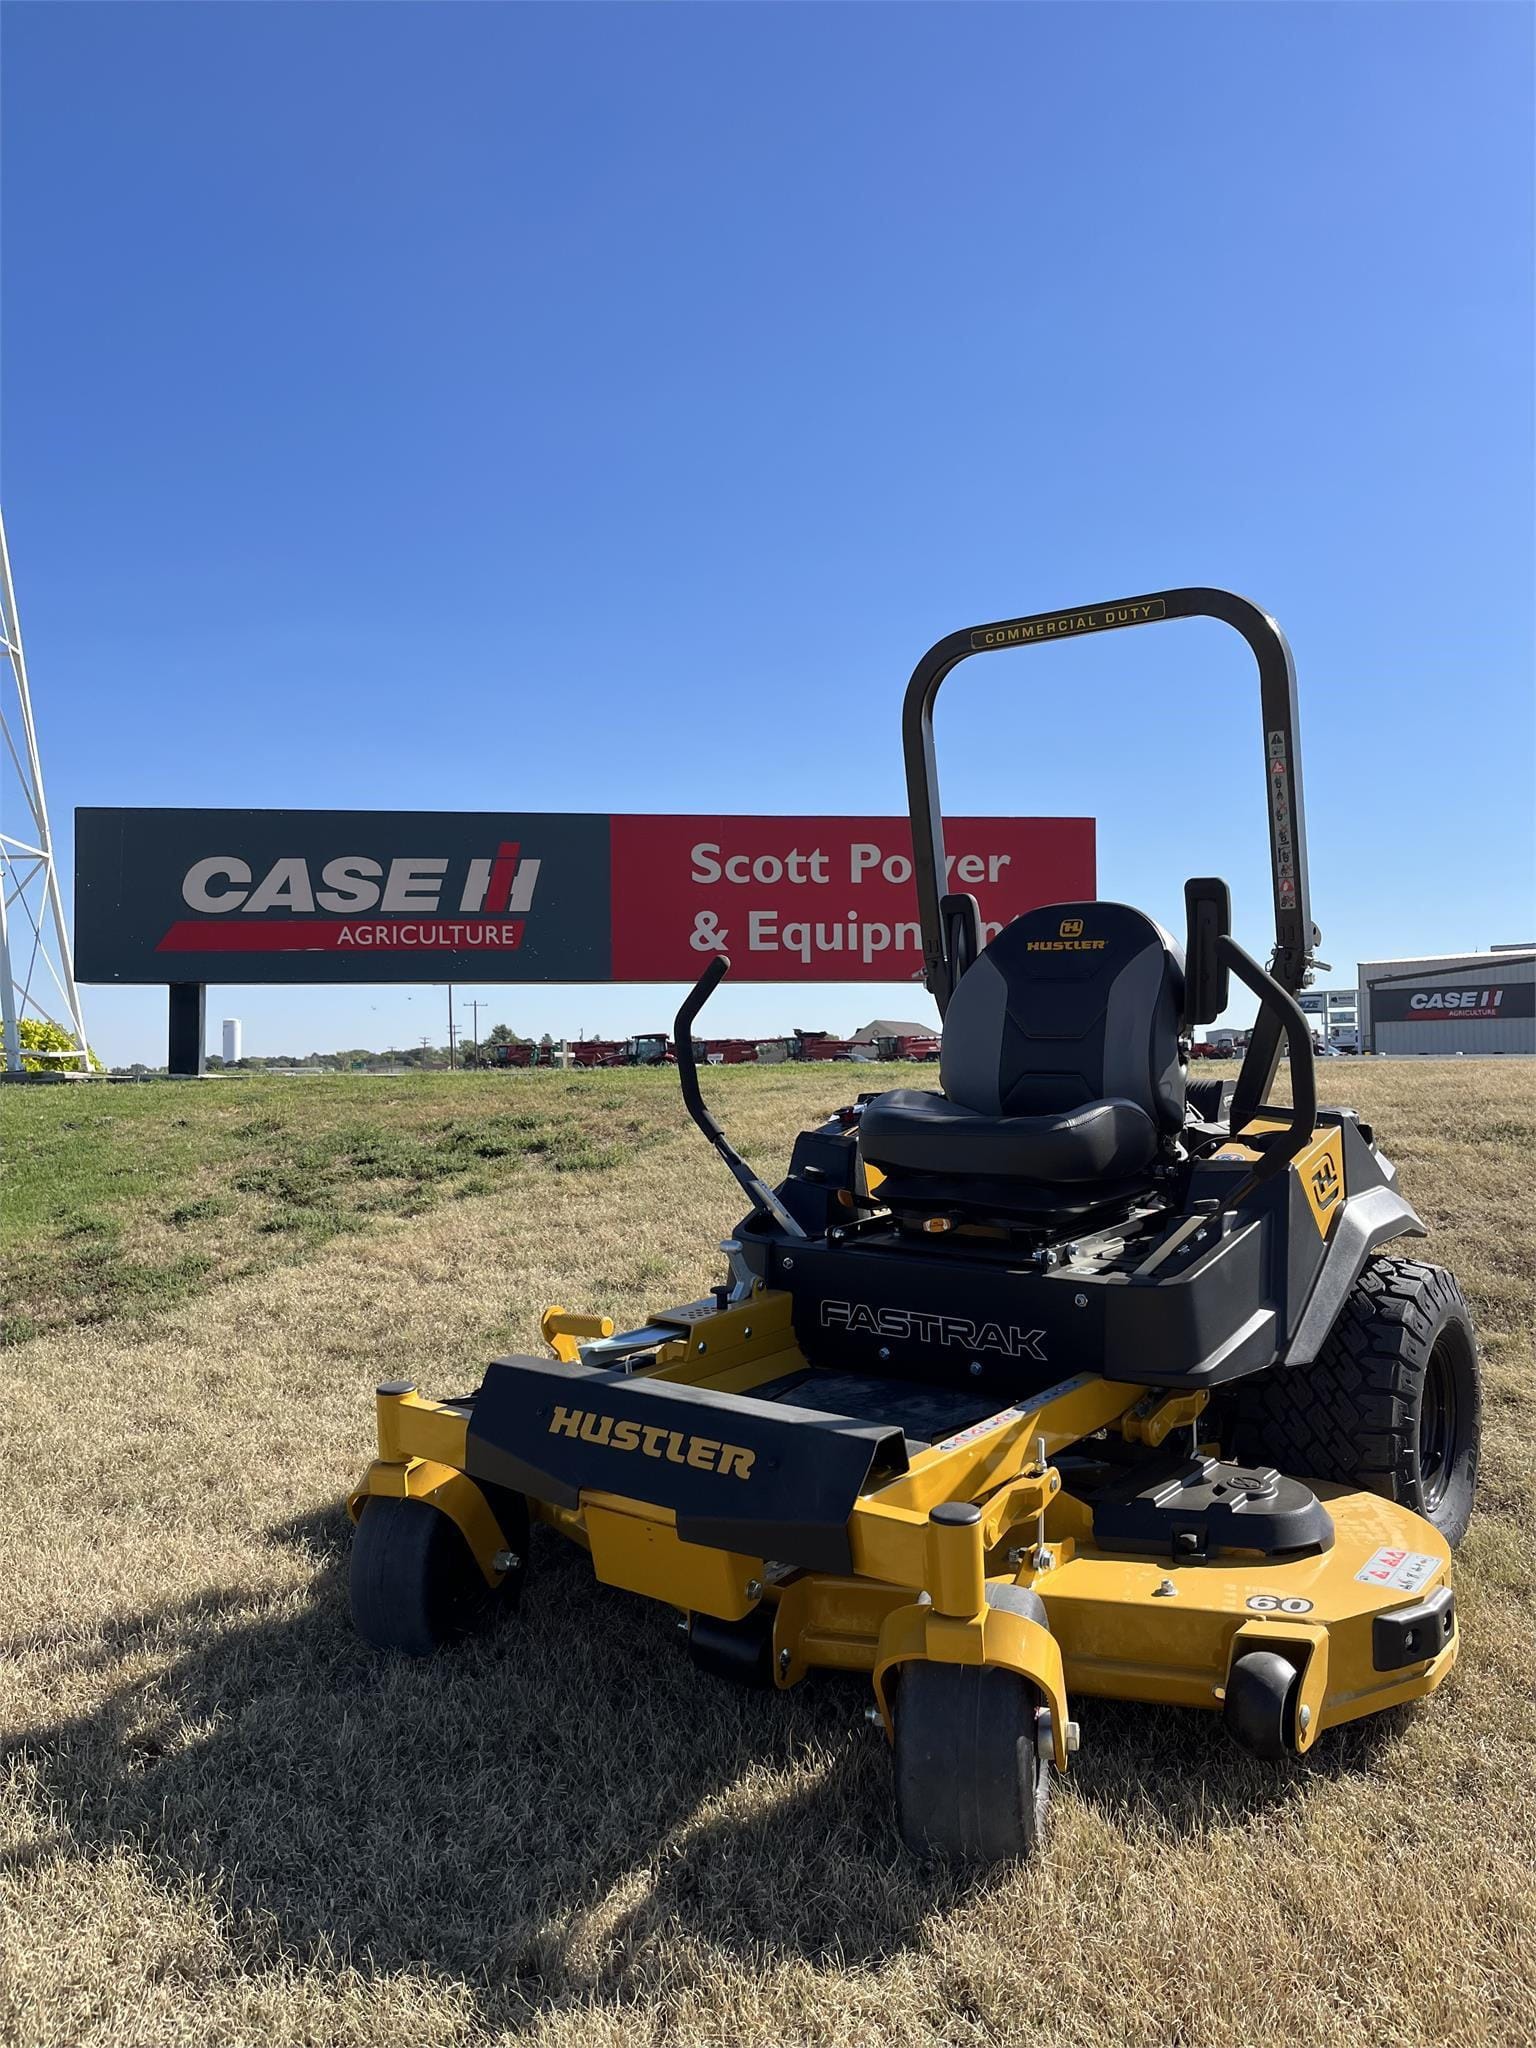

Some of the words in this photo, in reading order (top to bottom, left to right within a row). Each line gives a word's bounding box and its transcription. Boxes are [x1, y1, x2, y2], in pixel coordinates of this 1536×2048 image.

[985, 614, 1096, 645] COMMERCIAL
[1105, 605, 1152, 624] DUTY
[689, 842, 830, 884] Scott
[850, 843, 1012, 884] Poer
[181, 855, 450, 914] CASE
[336, 924, 515, 946] AGRICULTURE
[689, 910, 730, 952] &
[1026, 940, 1105, 951] HUSTLER
[1410, 991, 1478, 1010] CASE
[1449, 1008, 1496, 1017] AGRICULTURE
[820, 1299, 1049, 1361] FASTRAK
[548, 1405, 756, 1480] HUSTLER
[1246, 1594, 1314, 1614] 60
